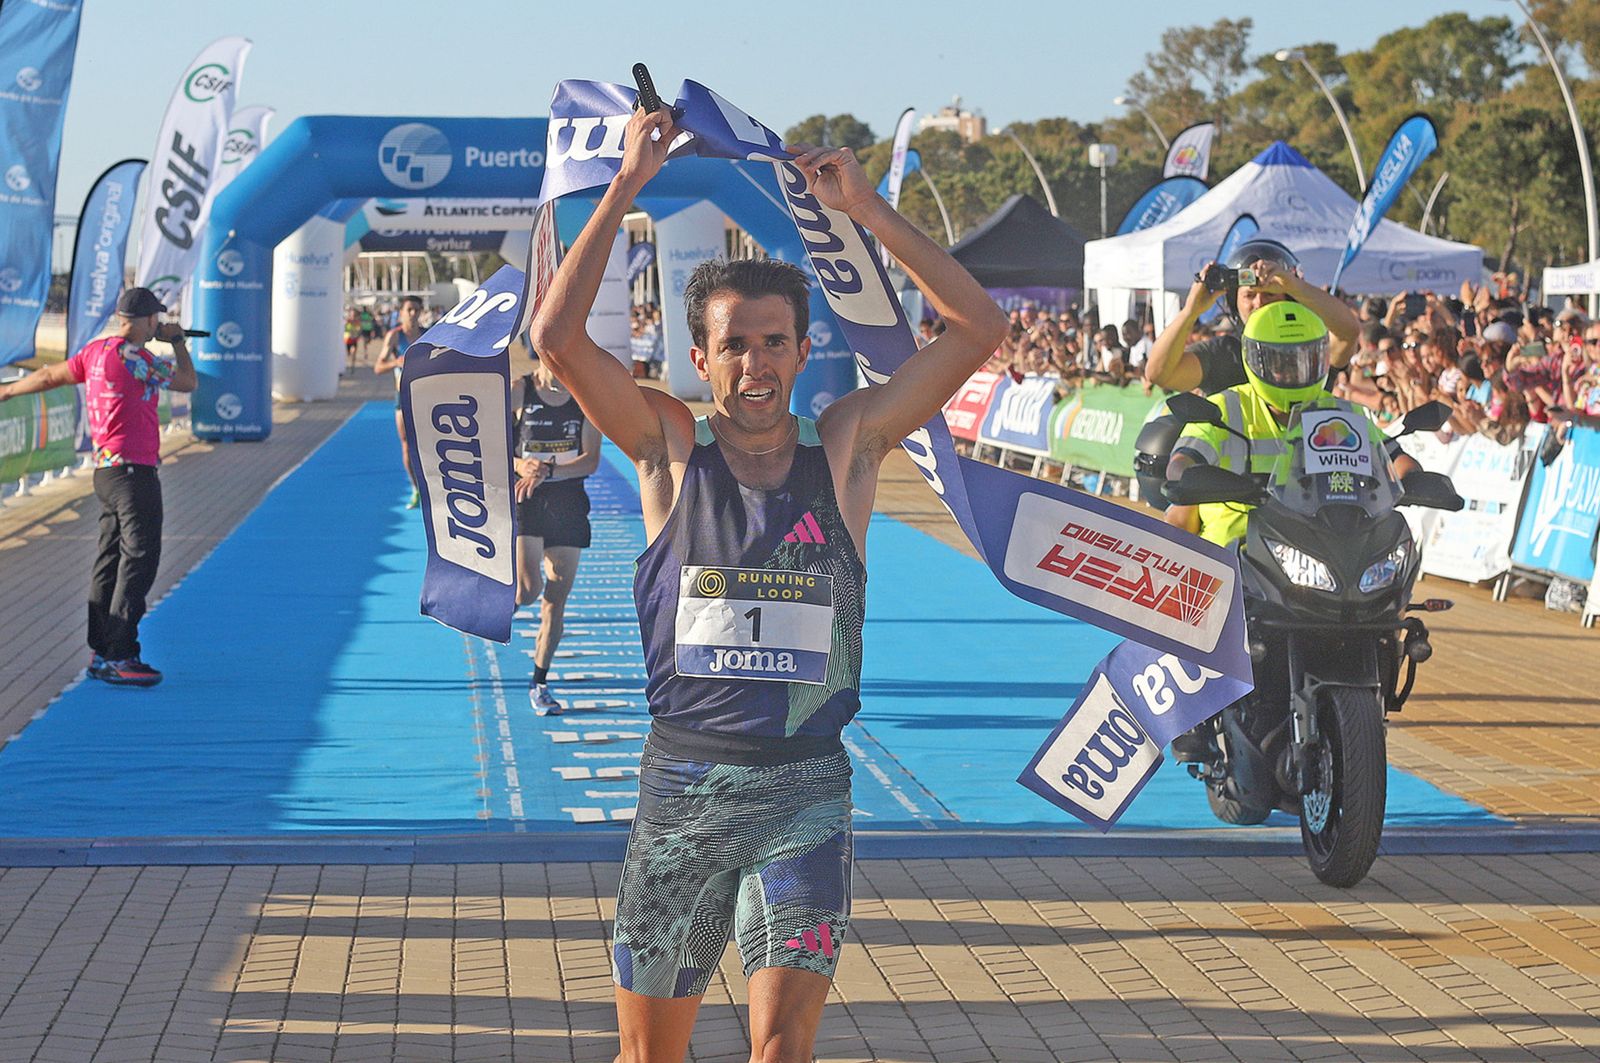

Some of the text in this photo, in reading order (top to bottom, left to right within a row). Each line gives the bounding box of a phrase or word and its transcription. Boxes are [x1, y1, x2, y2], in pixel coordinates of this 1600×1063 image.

[195, 74, 233, 94] CSIF
[465, 146, 543, 168] Puerto
[155, 131, 210, 251] CSIF
[424, 204, 538, 217] ATLANTIC COPPE
[84, 180, 123, 317] Huelva original
[1319, 453, 1358, 467] WiHu
[1059, 522, 1186, 576] ATLETISMO
[737, 572, 816, 588] RUNNING
[757, 588, 804, 600] LOOP
[743, 607, 762, 643] 1
